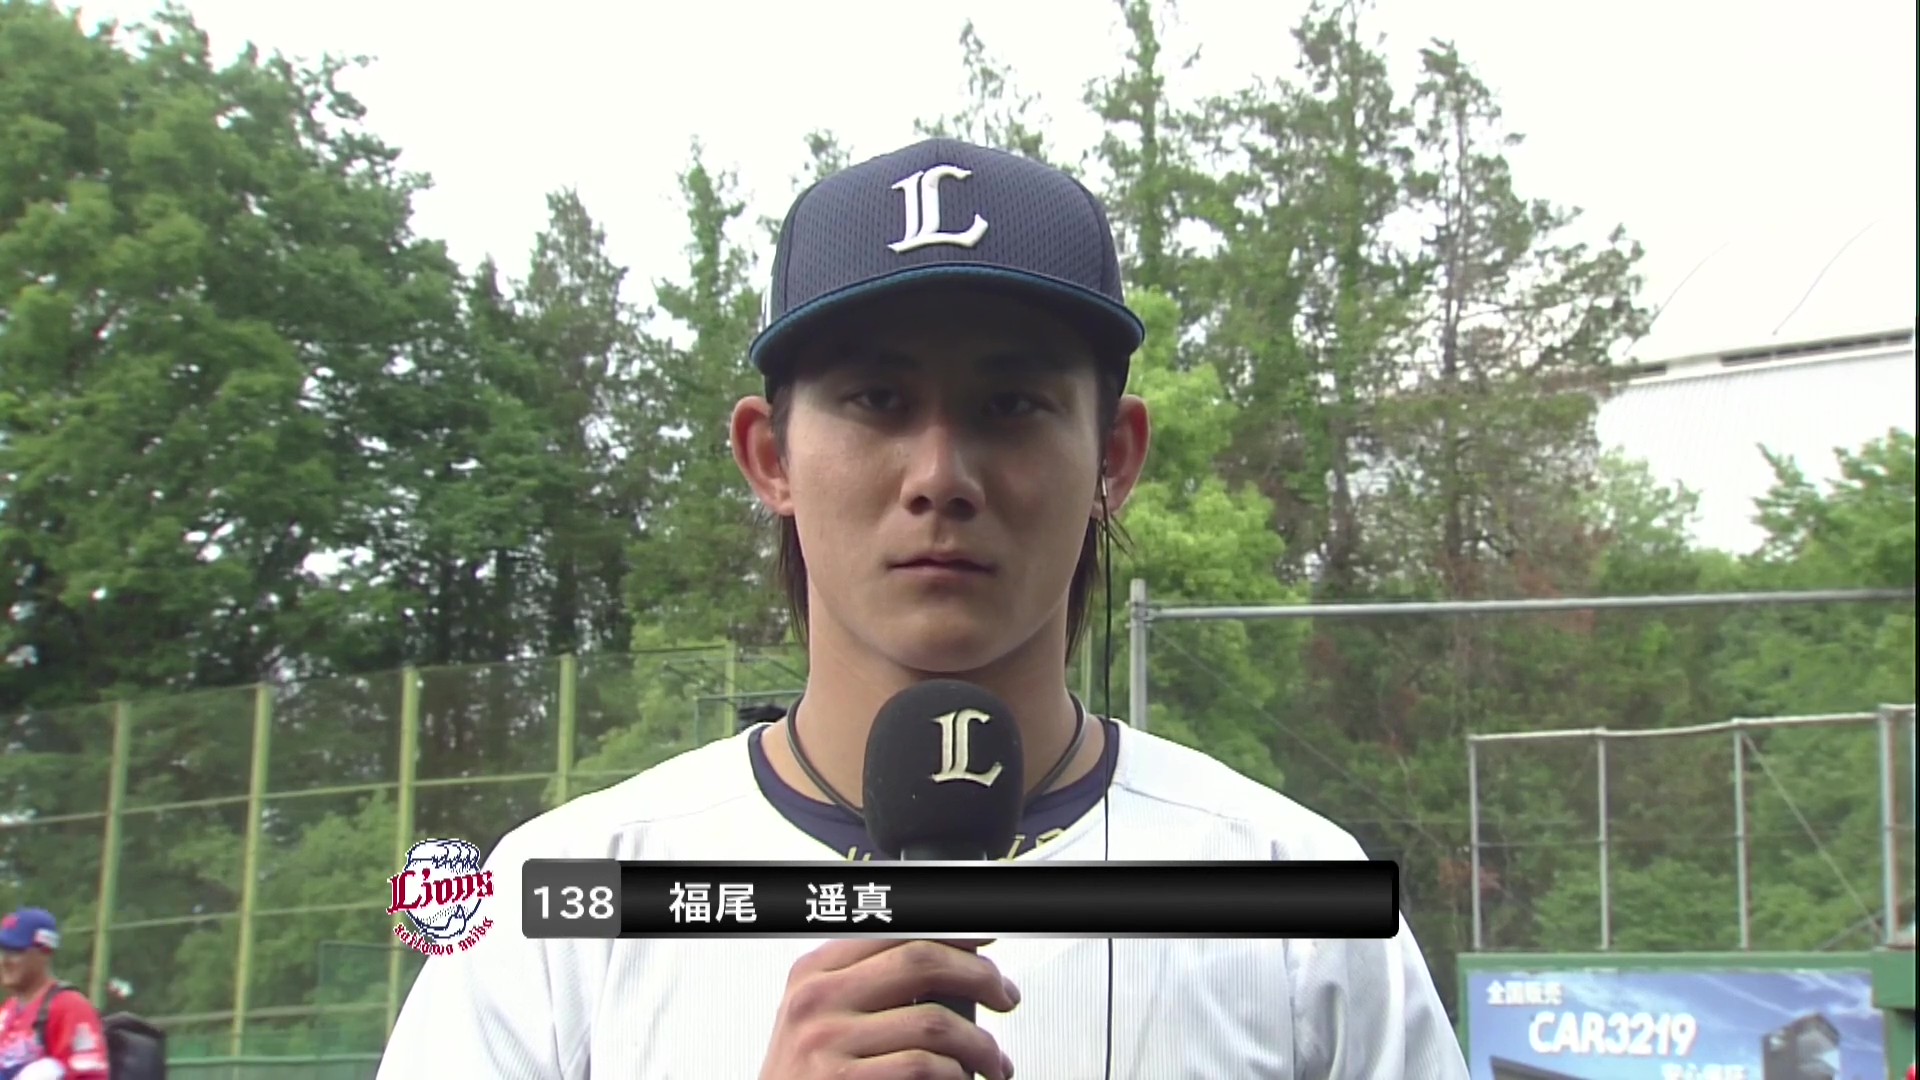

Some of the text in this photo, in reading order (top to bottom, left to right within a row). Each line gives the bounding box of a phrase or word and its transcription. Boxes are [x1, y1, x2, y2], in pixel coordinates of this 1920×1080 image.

[888, 164, 989, 253] L
[930, 708, 1003, 788] L
[1528, 1011, 1698, 1057] CAR3219
